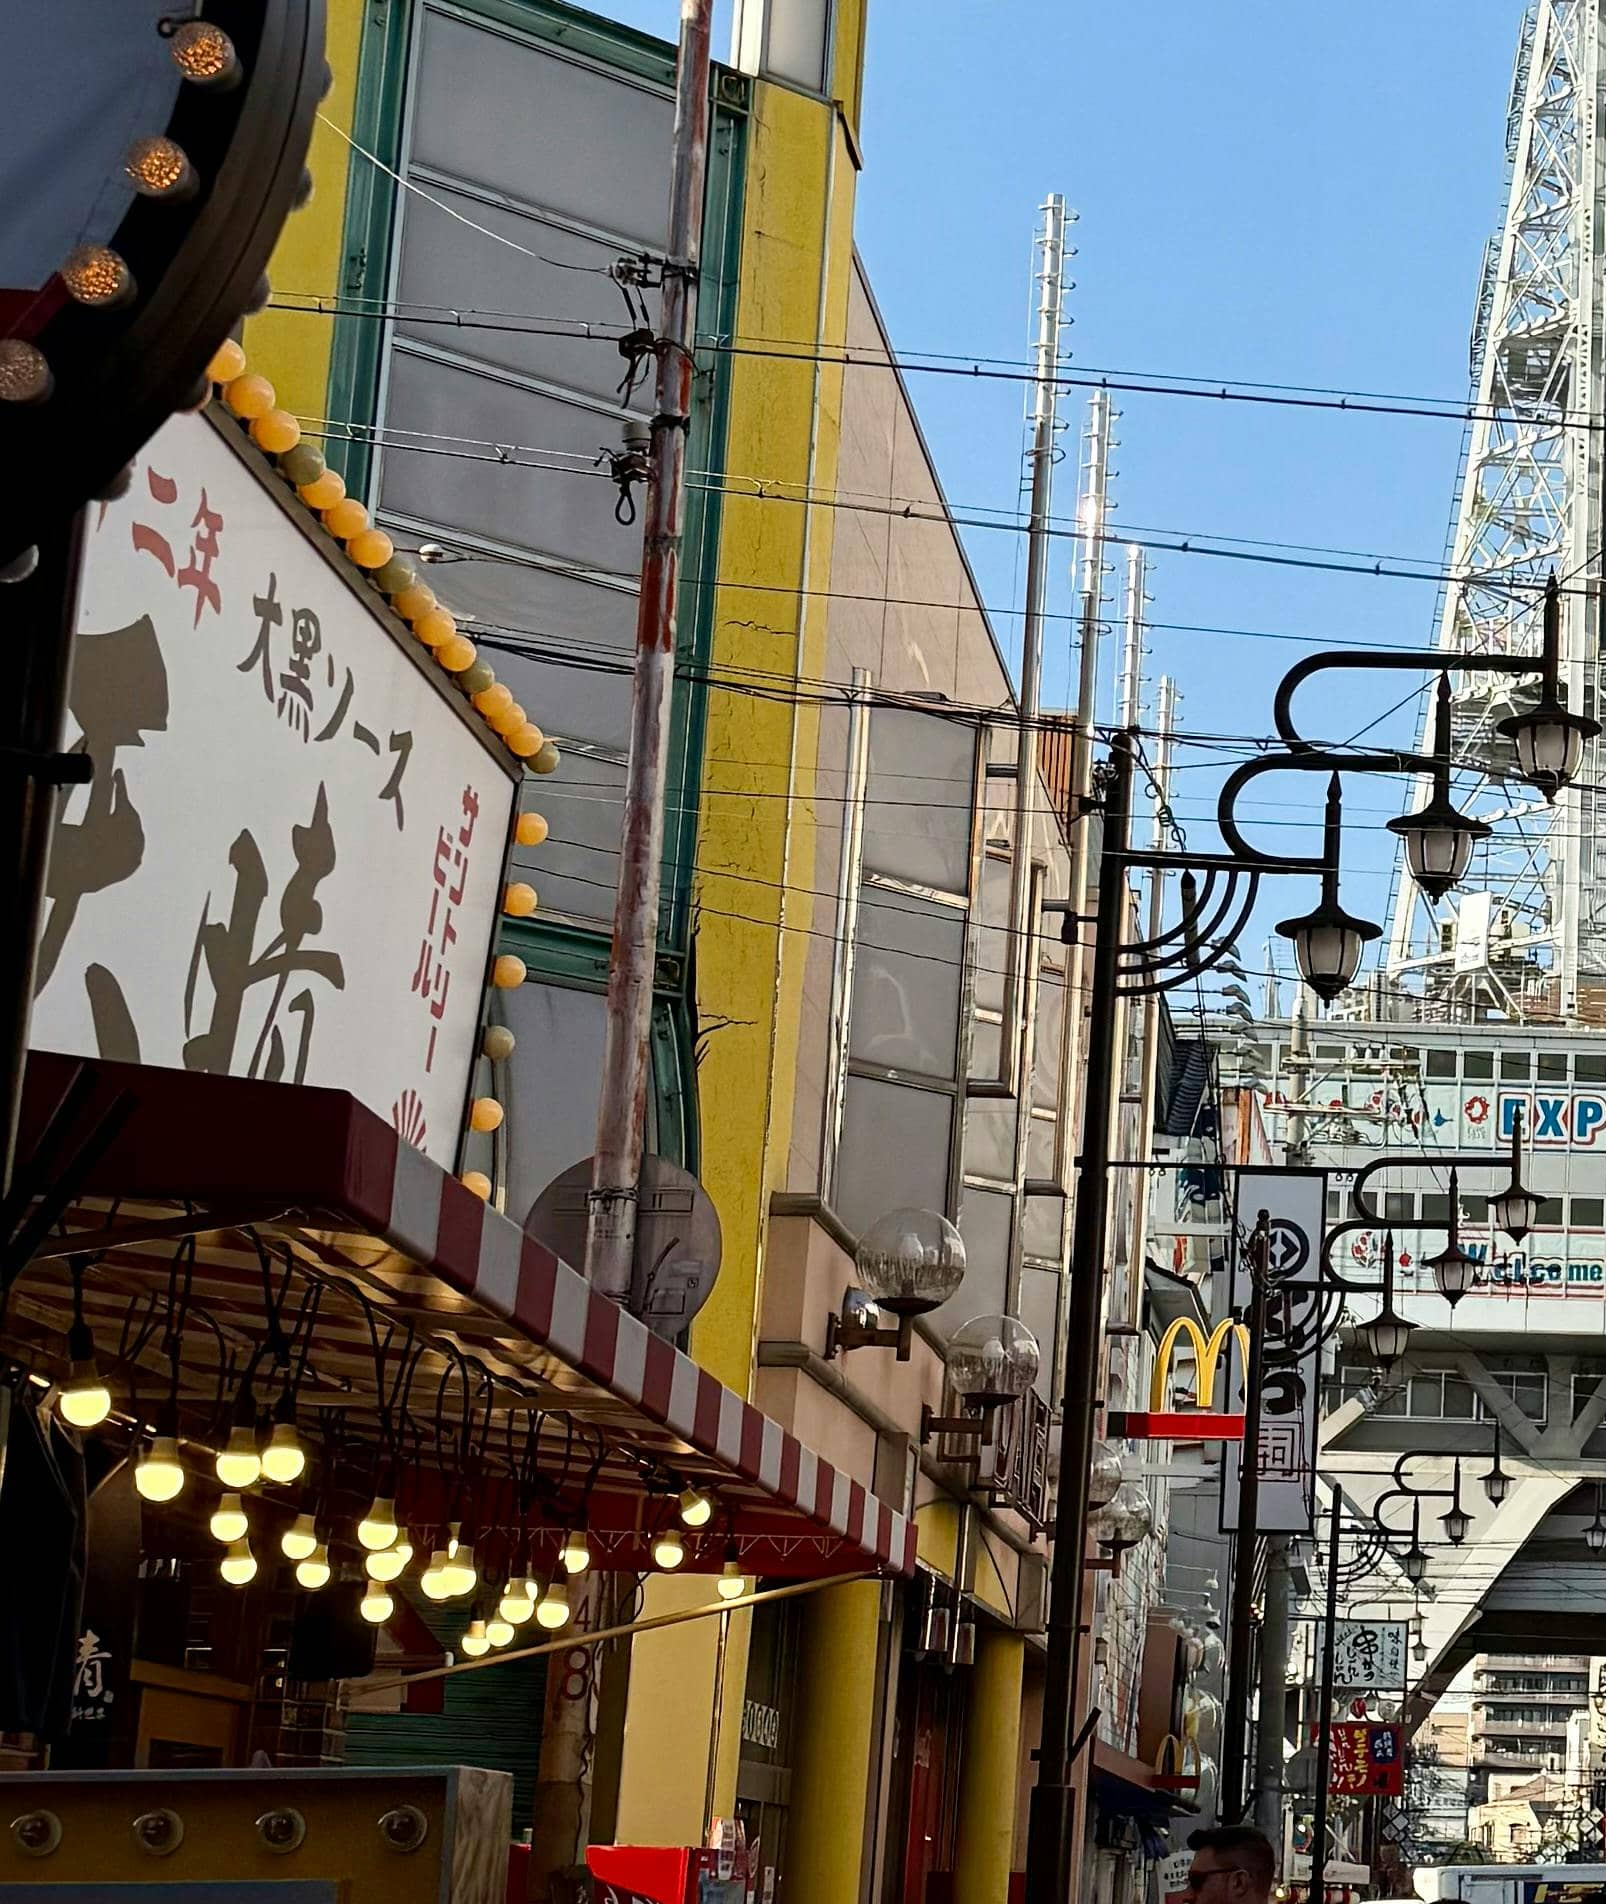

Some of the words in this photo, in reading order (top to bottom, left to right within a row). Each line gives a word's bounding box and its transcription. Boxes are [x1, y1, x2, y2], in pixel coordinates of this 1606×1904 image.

[95, 466, 225, 630] 二年
[237, 571, 415, 831] 大黒ソース
[411, 824, 453, 998] ビール
[425, 783, 480, 1075] サントリー
